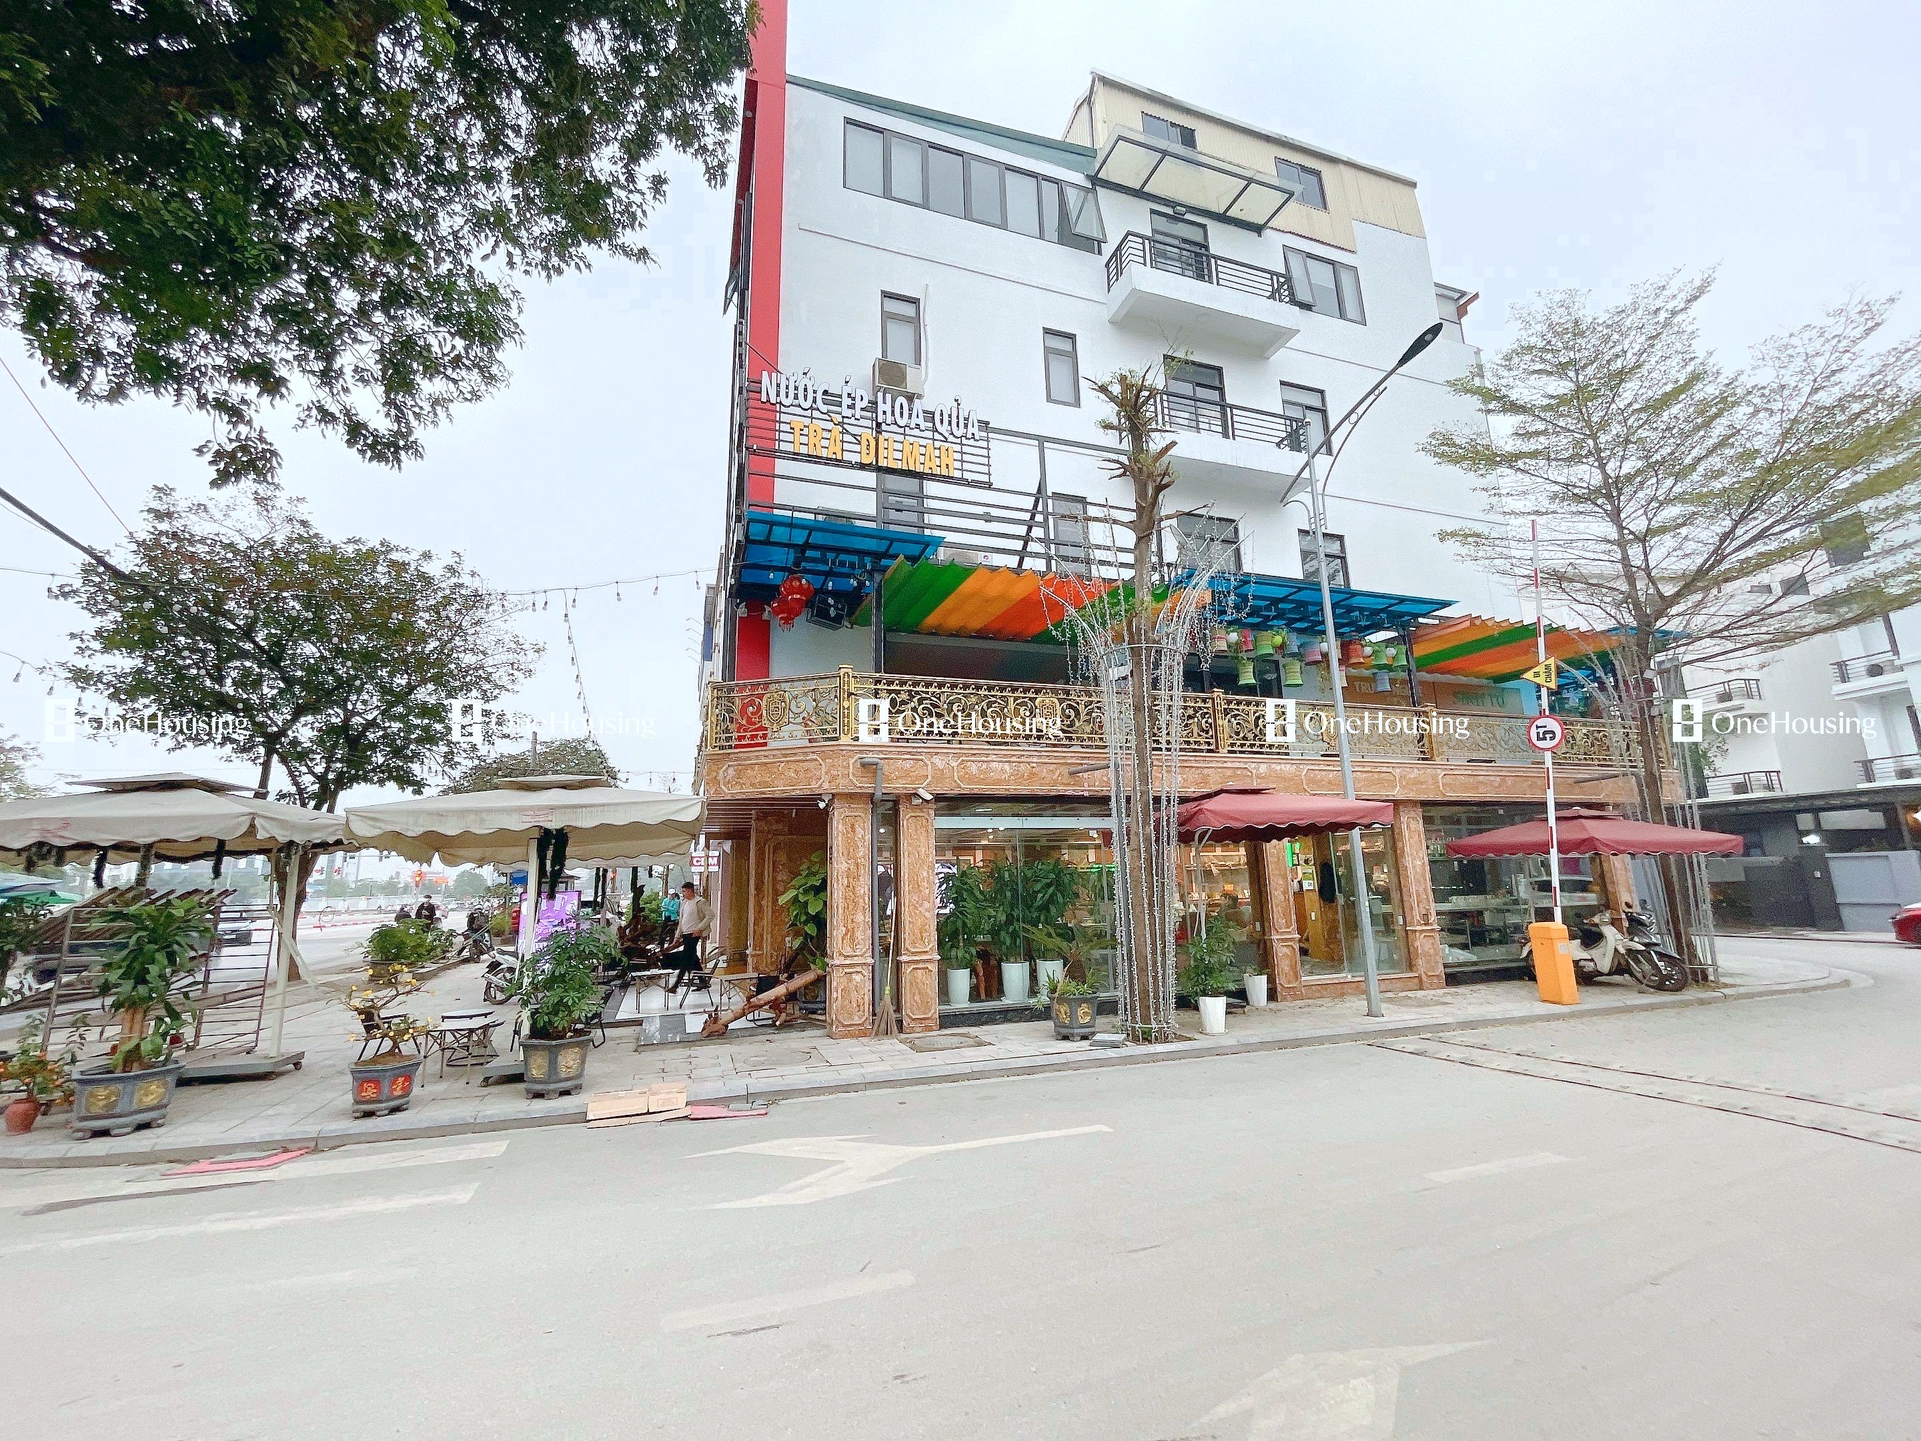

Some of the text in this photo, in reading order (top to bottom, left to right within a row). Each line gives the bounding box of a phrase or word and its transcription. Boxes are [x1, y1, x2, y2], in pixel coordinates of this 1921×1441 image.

[760, 367, 831, 414] NƯỚC
[841, 375, 869, 420] ÉP
[877, 392, 926, 431] HOA
[790, 416, 955, 477] TRÀ DILMAH
